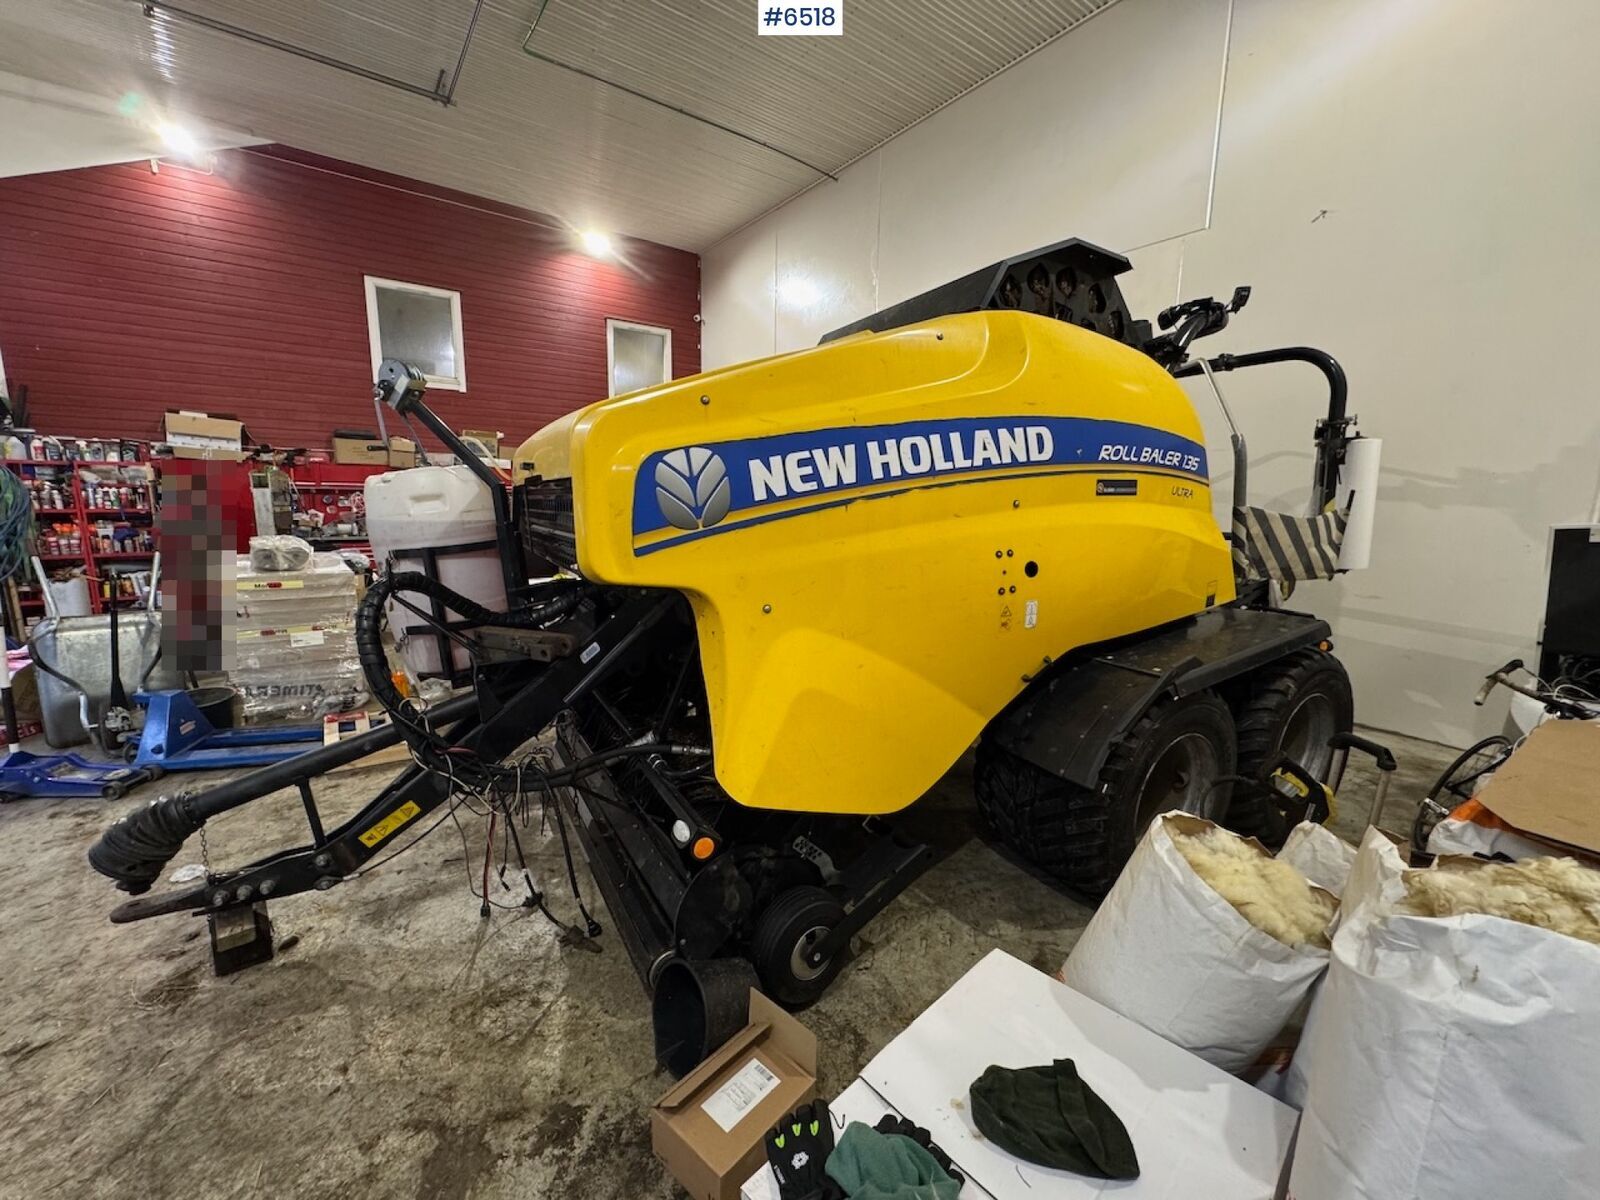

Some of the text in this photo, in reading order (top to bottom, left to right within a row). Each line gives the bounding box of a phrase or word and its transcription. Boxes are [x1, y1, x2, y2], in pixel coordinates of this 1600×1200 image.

[748, 425, 1054, 502] NEW HOLLAND
[1098, 444, 1201, 471] ROLL BALER 135
[1171, 486, 1194, 500] ULTRA
